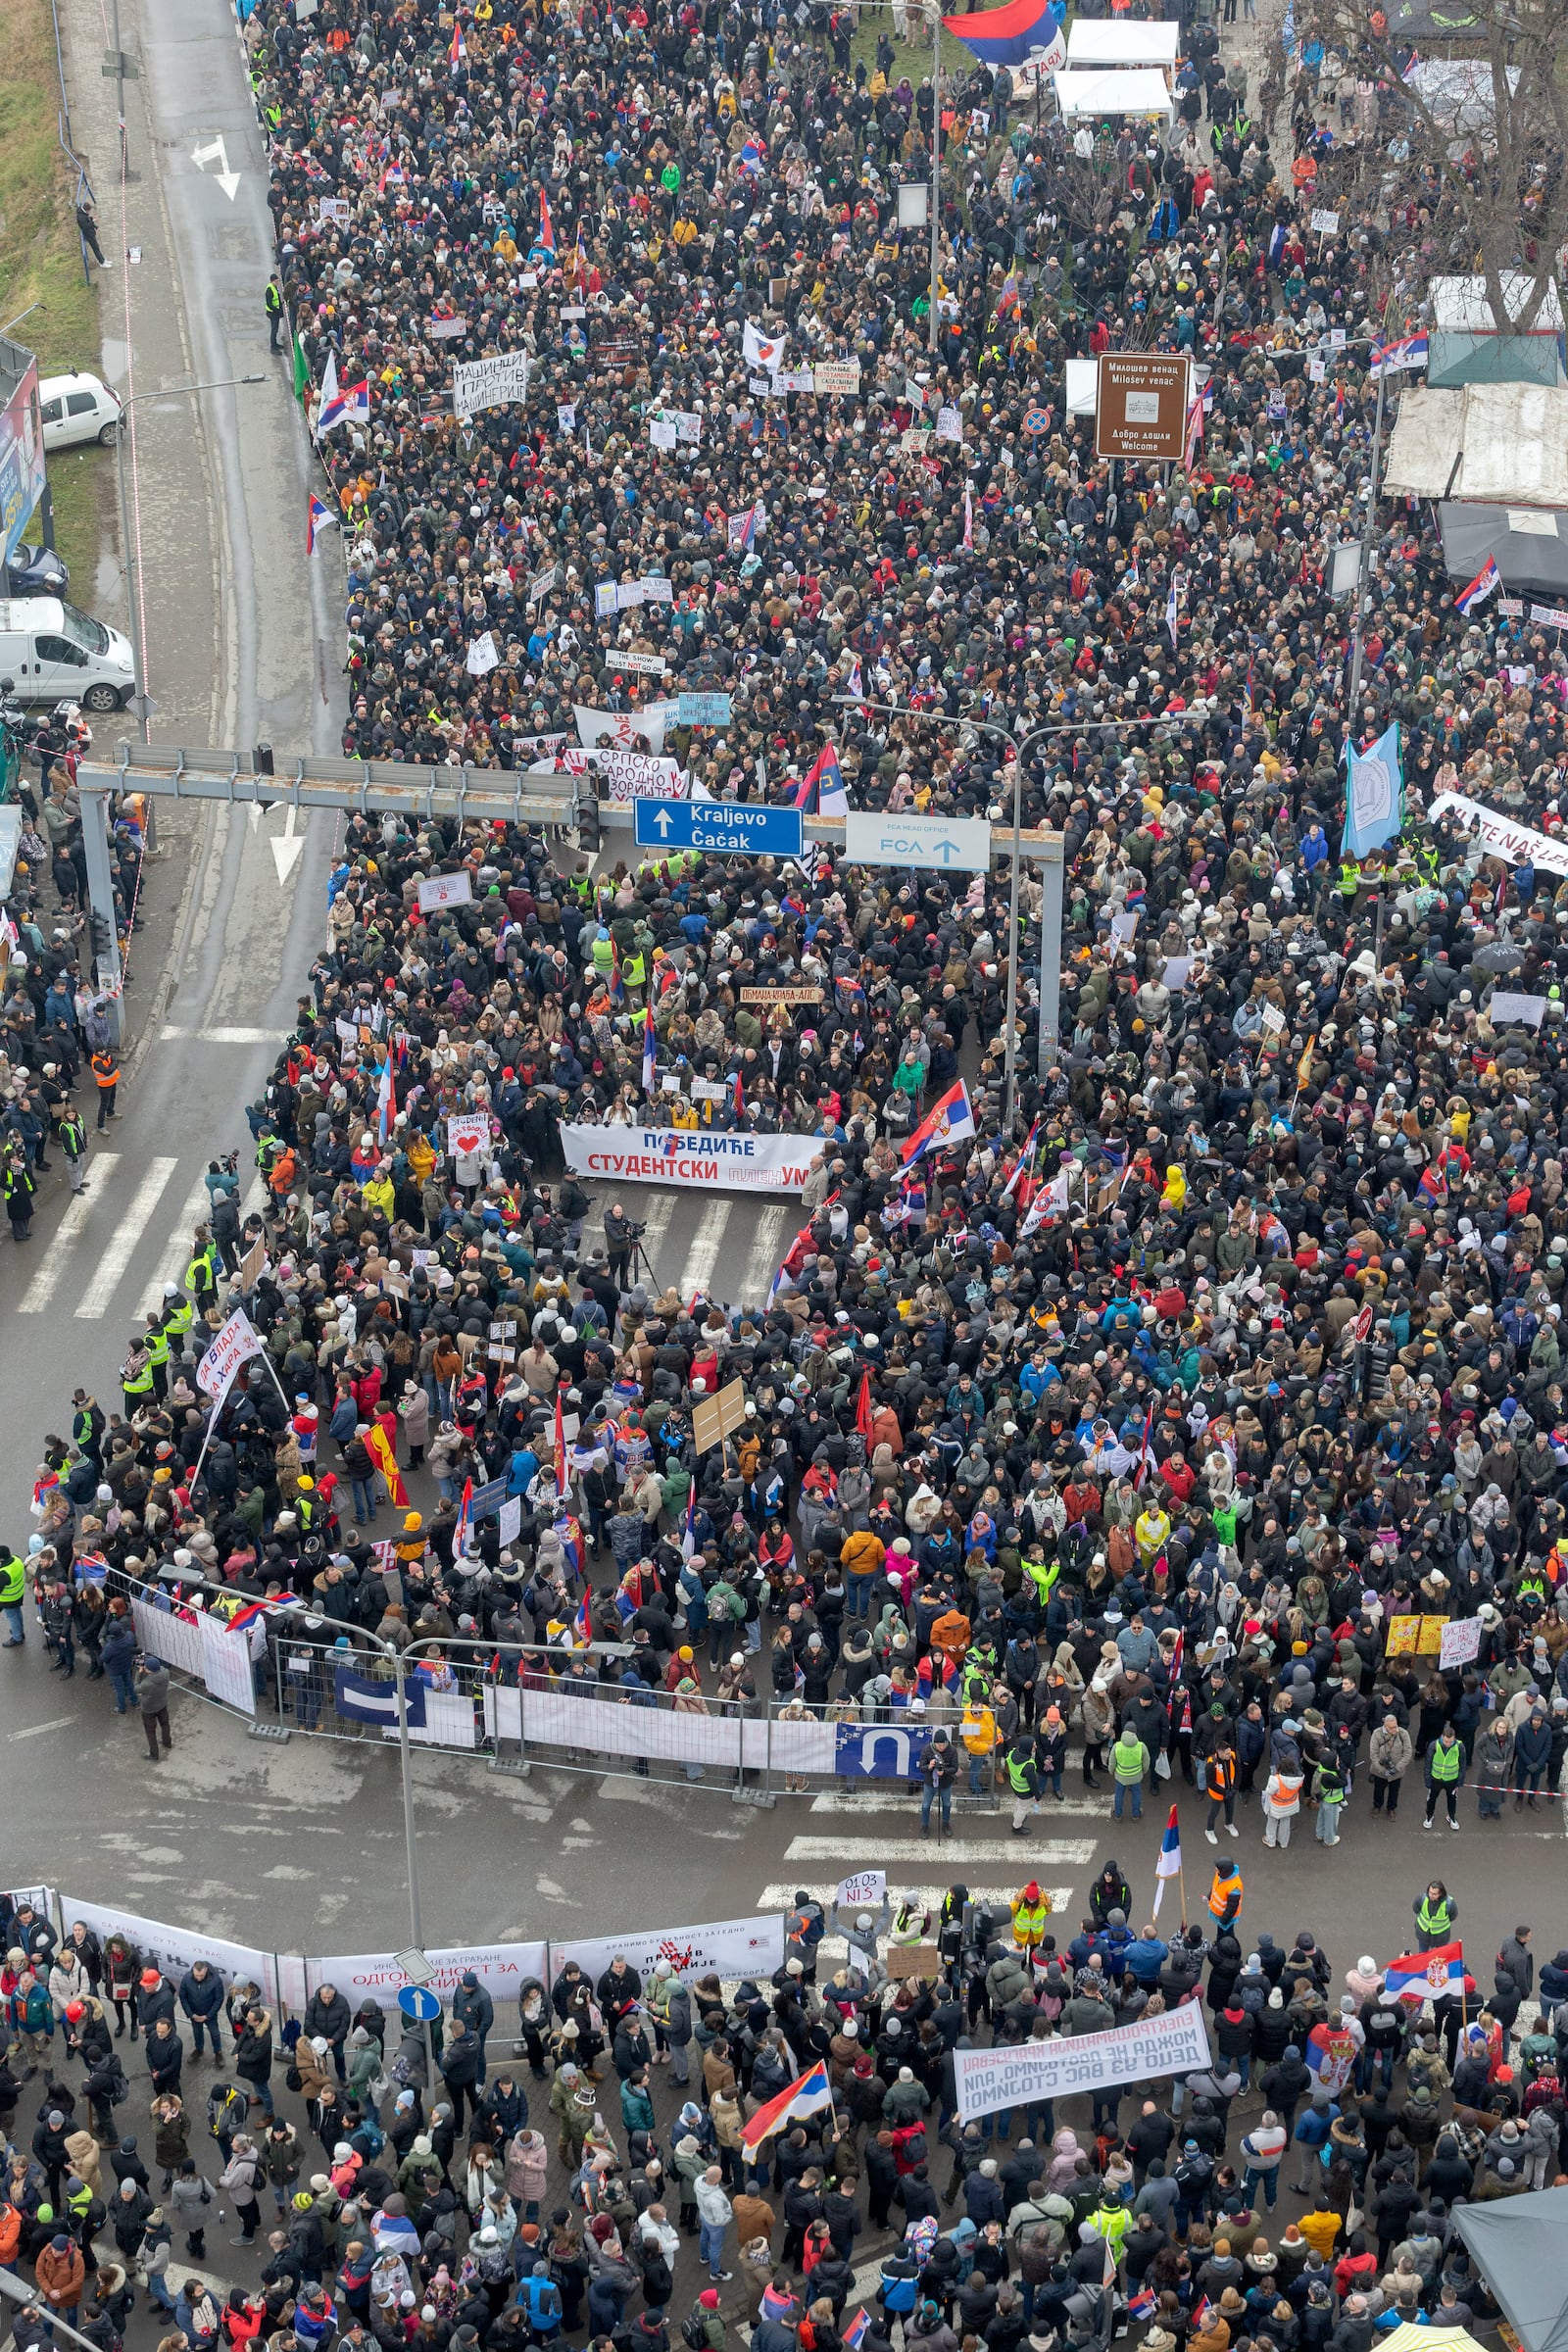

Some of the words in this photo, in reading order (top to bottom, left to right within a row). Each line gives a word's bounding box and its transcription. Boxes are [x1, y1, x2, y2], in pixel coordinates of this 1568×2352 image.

[455, 353, 522, 383] МАШИНЦИ
[1109, 363, 1148, 372] Милошев
[1152, 366, 1178, 374] венац
[1112, 374, 1145, 384] Milošev
[463, 371, 524, 396] ПРОТИВ
[457, 385, 525, 414] МАШИНЕРИЈЕ
[1112, 429, 1139, 440] Добро
[1121, 441, 1157, 451] Welcome
[632, 655, 654, 663] SHOW
[600, 751, 660, 772] СРПСКО
[690, 805, 767, 830] Kraljevo
[691, 826, 750, 849] Čačak
[880, 839, 924, 854] FCA
[1498, 833, 1544, 857] NAŠ
[588, 1153, 718, 1180] СТУДЕНТСКИ
[1356, 1313, 1371, 1336] STOP
[199, 1363, 211, 1387] ДА
[209, 1322, 241, 1364] ВЛАДА
[217, 1348, 242, 1383] ХАРА
[606, 1939, 648, 1950] БРАНИМО
[649, 1933, 703, 1945] БУДУЋНОСТ
[705, 1927, 746, 1937] ЗАЈЕДНО
[460, 1954, 503, 1964] ГРАЂАНЕ
[645, 1949, 704, 1964] ПРОТИВ
[353, 1964, 492, 1985] ОДГОВРНОСТ
[497, 1963, 518, 1974] ЗА
[719, 1968, 766, 1980] РОФЕСОРЕ
